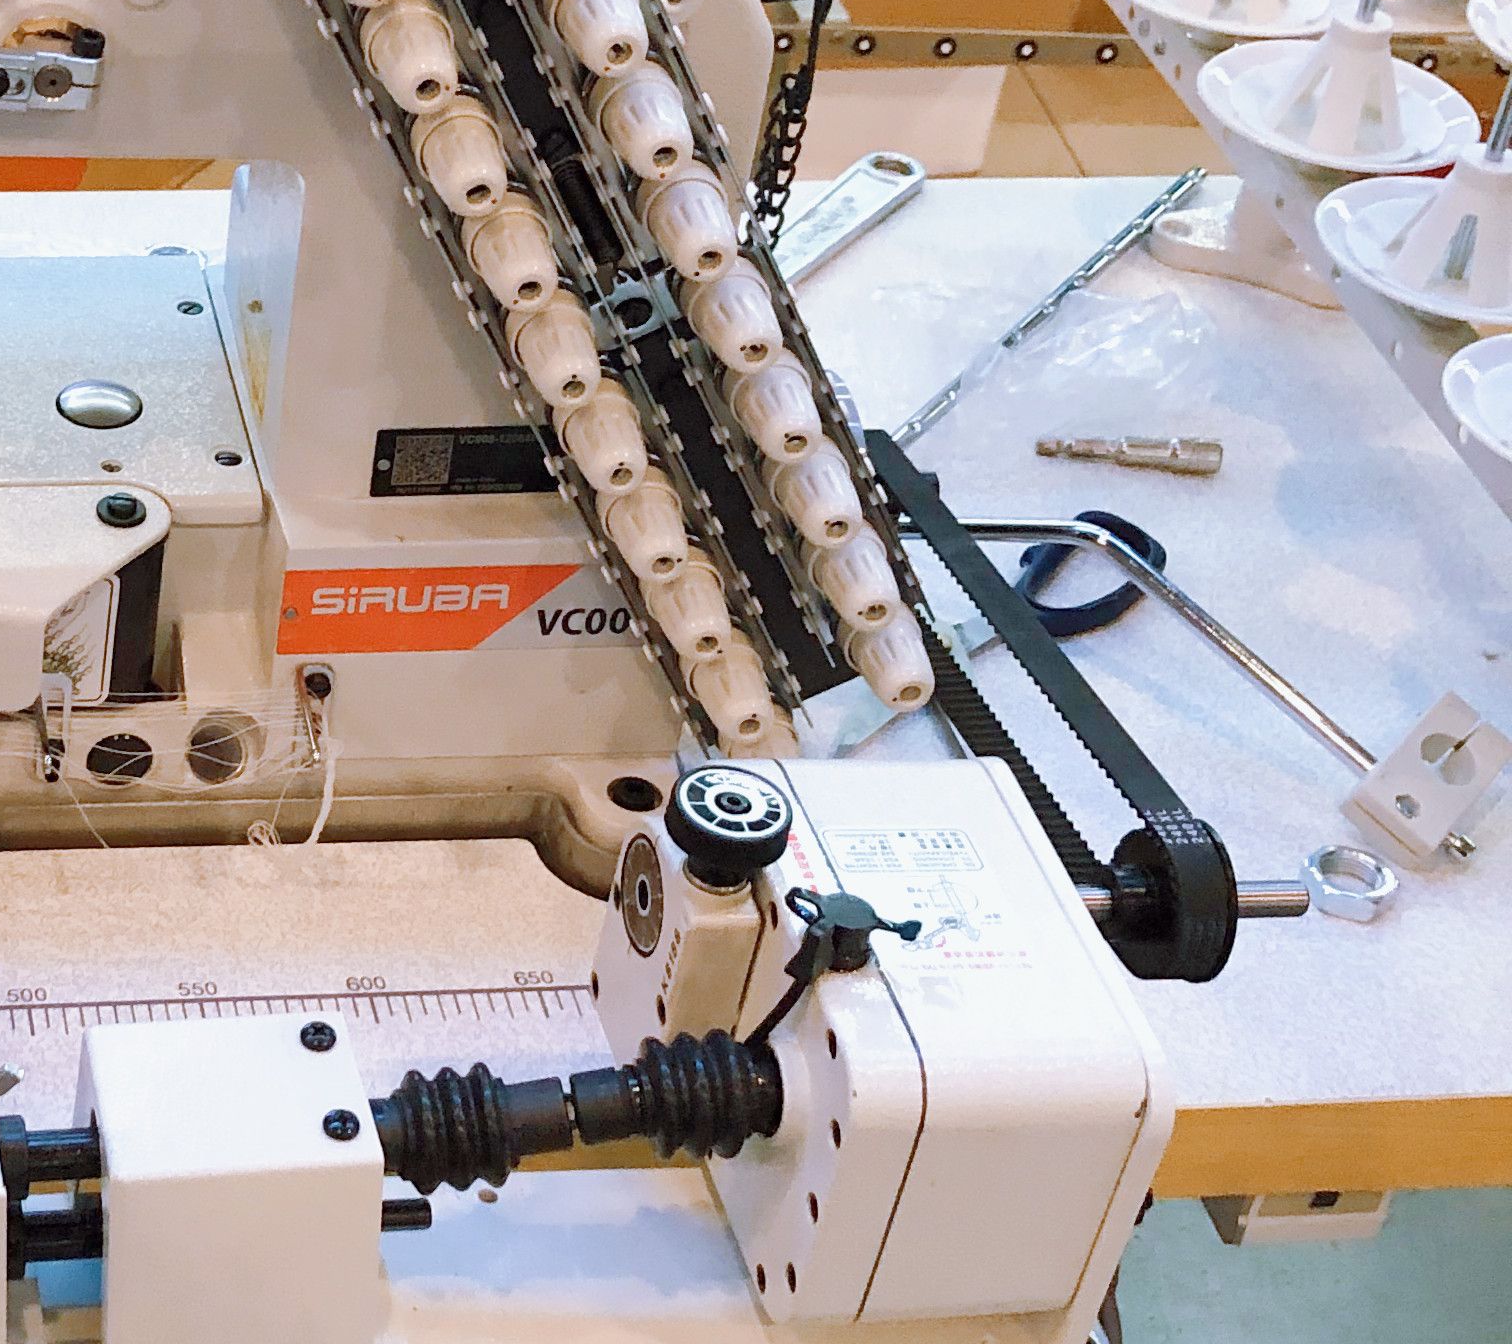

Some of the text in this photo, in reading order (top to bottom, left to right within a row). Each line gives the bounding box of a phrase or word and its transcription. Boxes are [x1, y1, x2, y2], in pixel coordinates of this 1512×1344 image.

[6, 970, 555, 1003] 500 550 600 650
